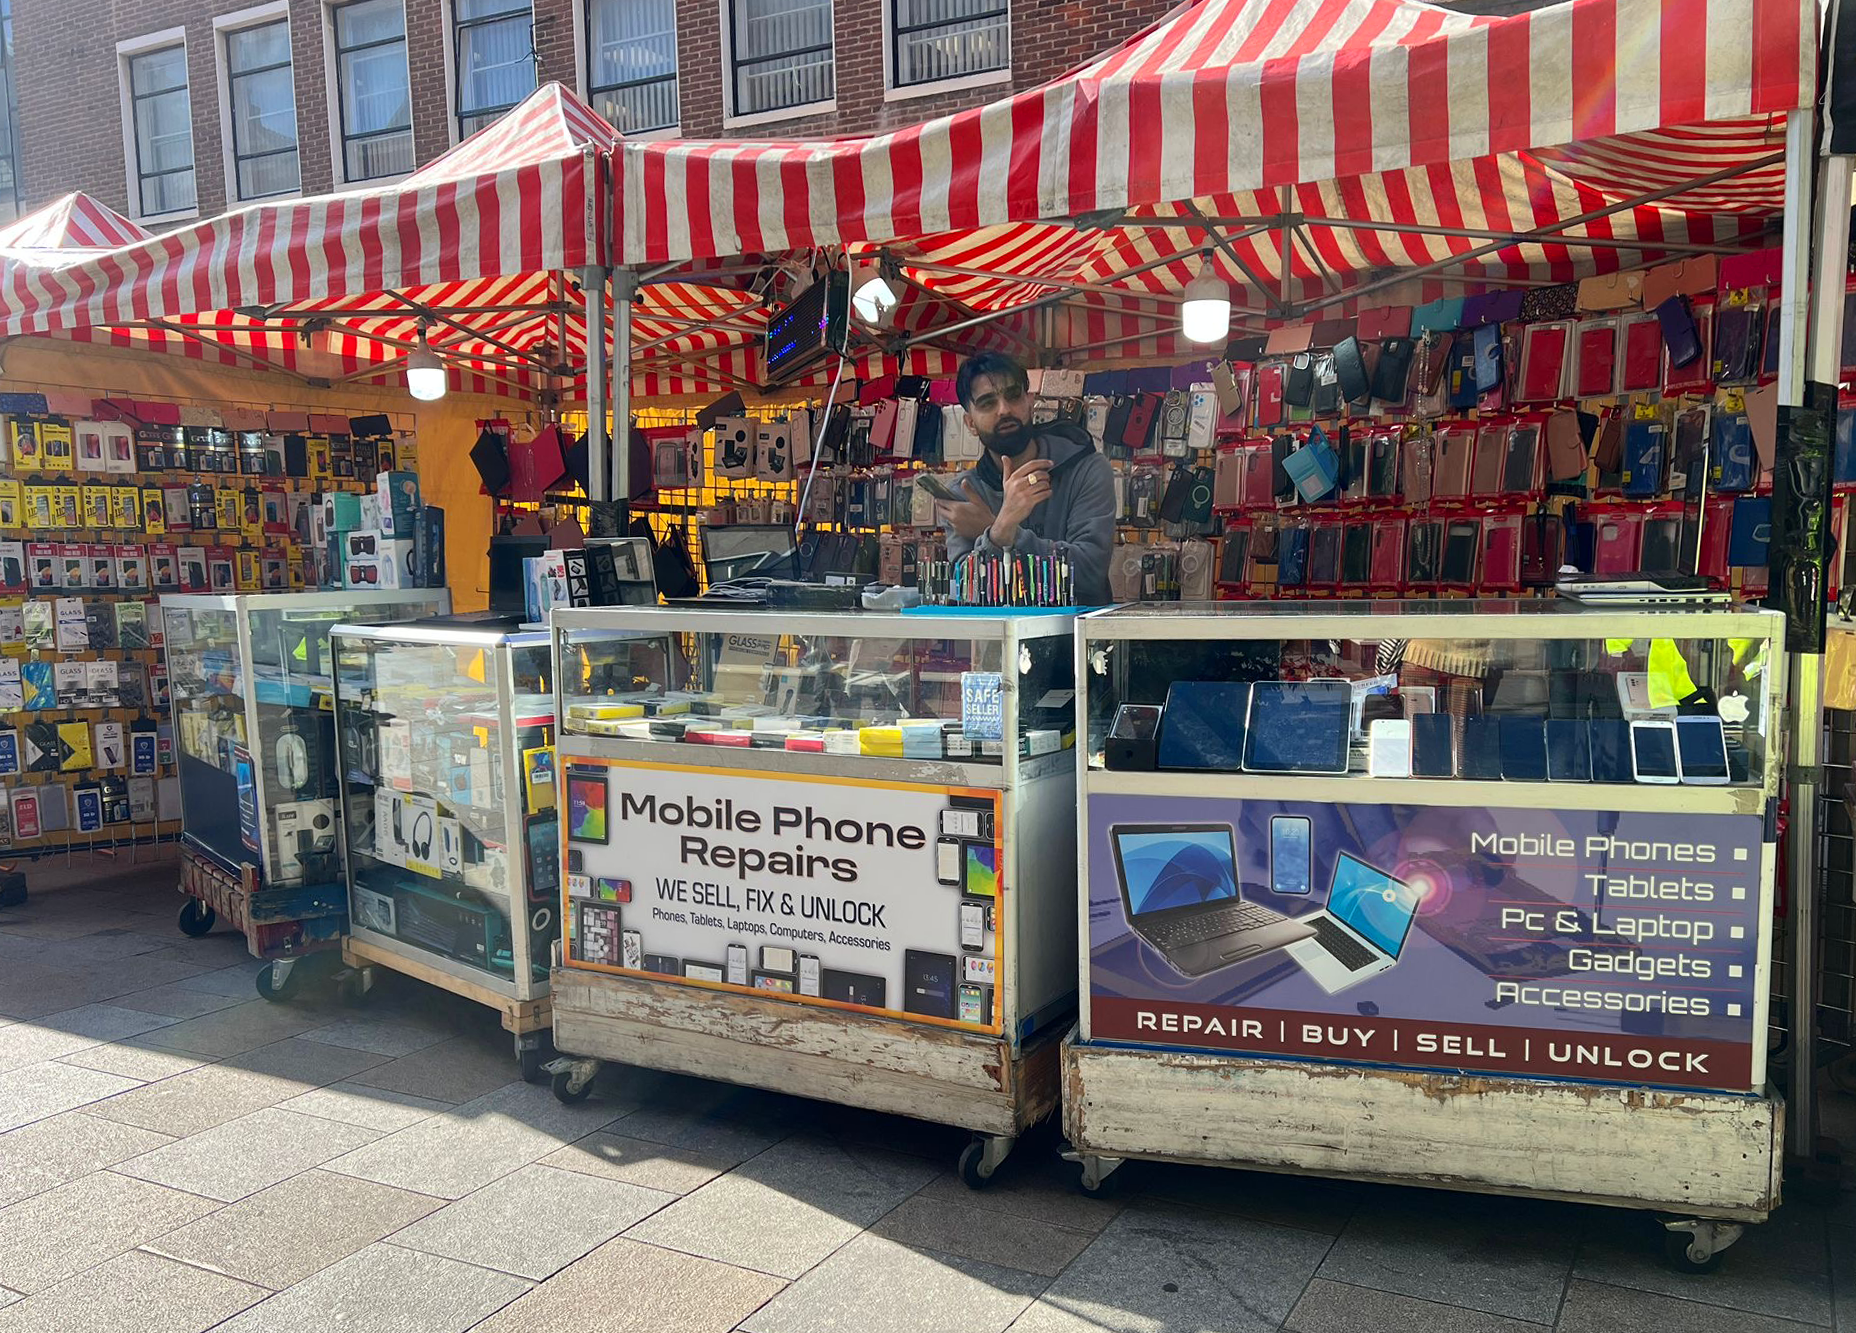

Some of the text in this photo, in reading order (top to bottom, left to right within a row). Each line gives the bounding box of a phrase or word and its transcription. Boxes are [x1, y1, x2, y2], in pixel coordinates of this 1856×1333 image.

[729, 635, 757, 649] GLASS
[966, 688, 1000, 704] SAFE
[966, 704, 999, 716] SELLER
[621, 792, 926, 851] Mobile Phone
[680, 835, 858, 882] Repairs
[1471, 832, 1716, 863] Mobile Phones
[655, 877, 886, 929] WE SELL, FIX & UNLOCK
[1584, 874, 1714, 902] Tablets
[652, 907, 891, 951] Phones, Tablets, Laptops, Computers, Accessories
[1502, 908, 1714, 945] Pc & Laptop
[1569, 949, 1711, 981] Gadgets
[1496, 982, 1710, 1016] Accessories
[1138, 1012, 1709, 1074] REPAIR BUY SELL UNLOCK
